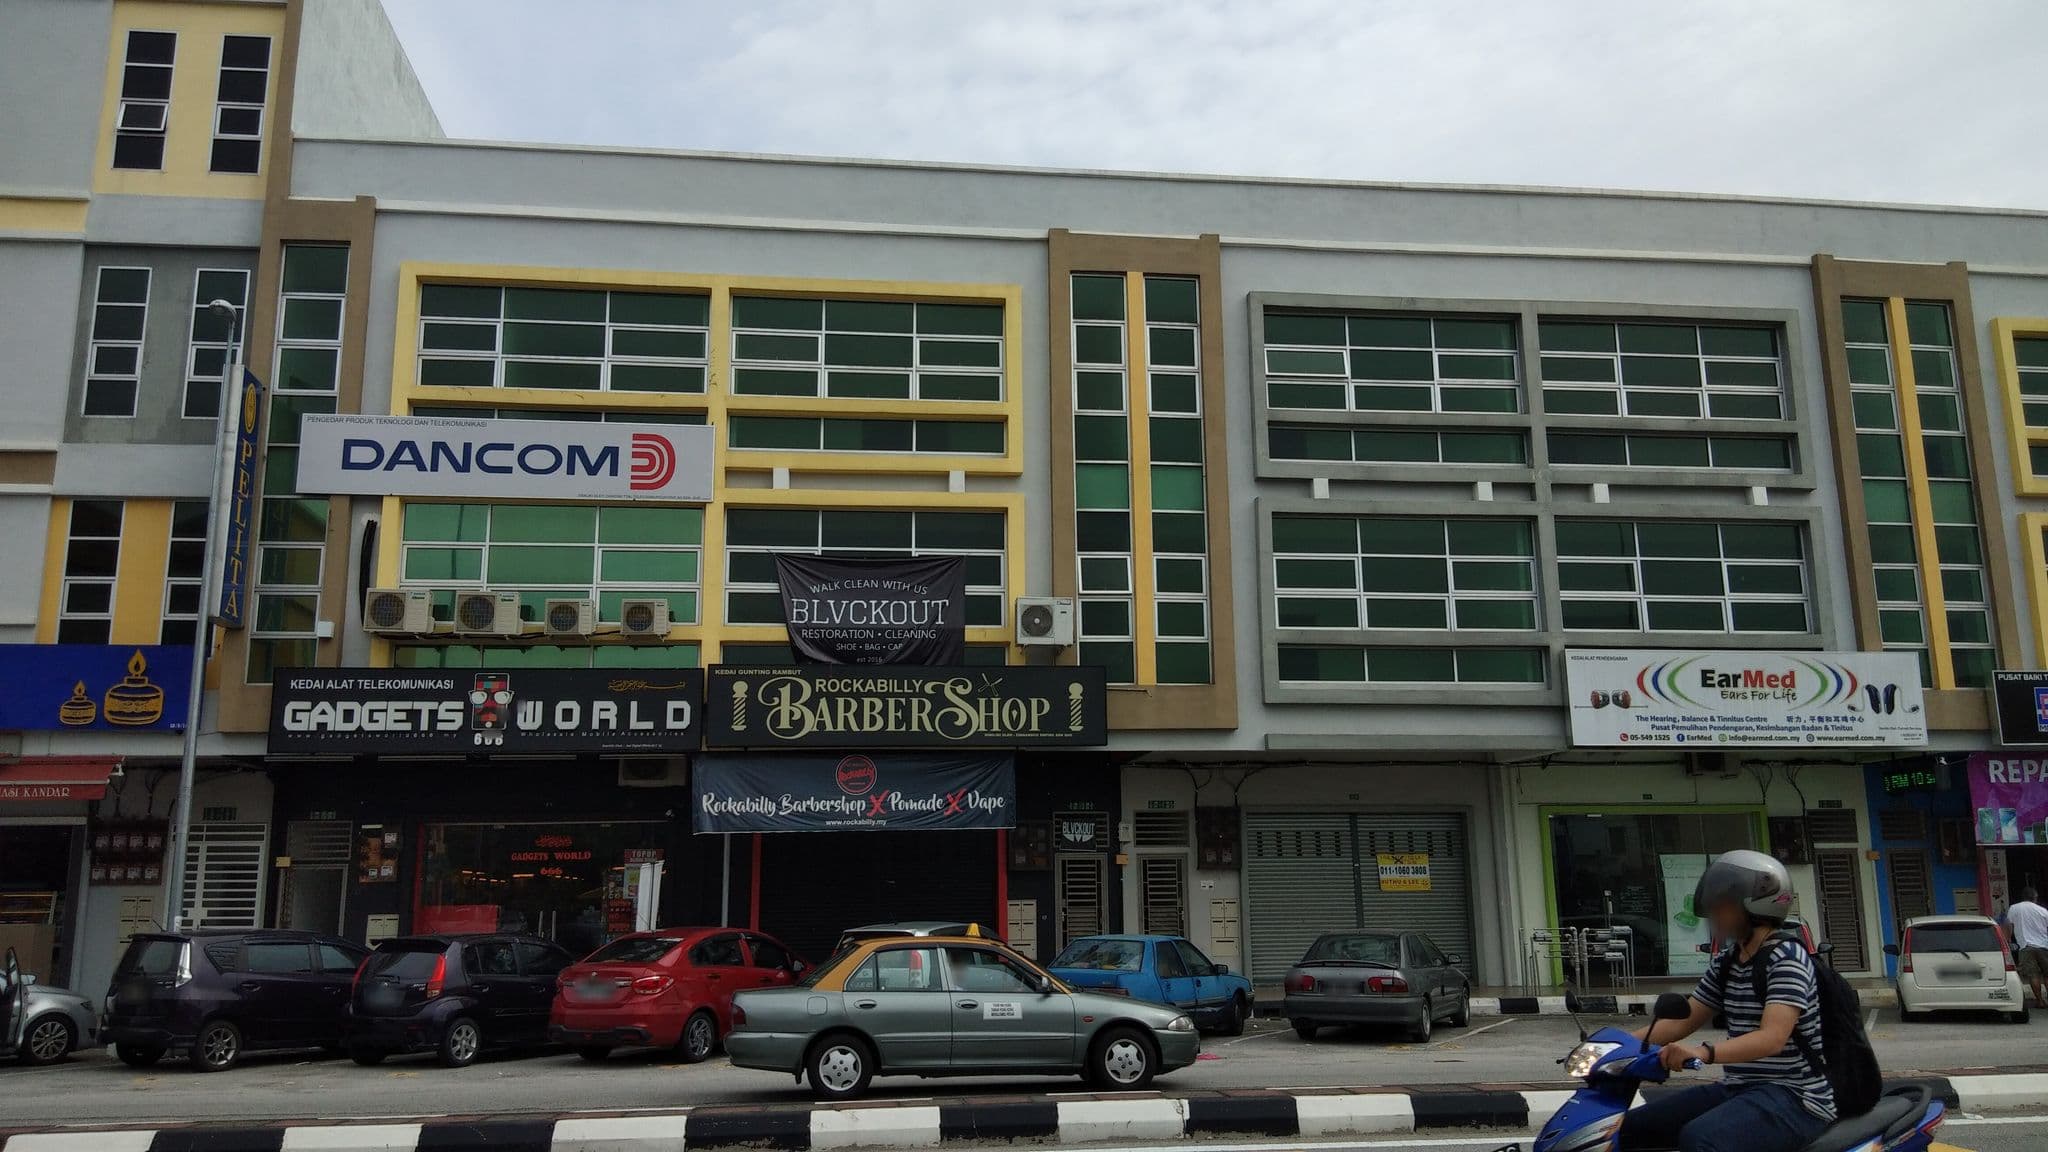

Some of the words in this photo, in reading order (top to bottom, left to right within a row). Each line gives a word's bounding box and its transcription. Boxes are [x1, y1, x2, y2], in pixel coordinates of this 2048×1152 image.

[306, 416, 344, 424] PENGEDAR
[345, 417, 374, 425] PRODUK
[376, 418, 413, 426] TEKNOLOGI
[430, 420, 488, 428] TELEKOMUNIKASI
[341, 438, 620, 477] DANCOM
[224, 438, 253, 618] PELITA
[809, 581, 841, 594] WALK
[844, 580, 879, 589] CLEAN
[882, 580, 910, 592] WITH
[913, 584, 928, 595] US
[790, 598, 949, 625] BLVCKOUT
[802, 629, 874, 639] RESTORATION
[885, 629, 937, 639] CLEANING
[836, 643, 857, 651] SHOE
[864, 643, 880, 651] BAG
[888, 643, 903, 651] CAP
[1701, 669, 1796, 688] EarMed
[1998, 673, 2022, 681] PUSAT
[2023, 673, 2043, 681] BAIKI
[290, 679, 324, 690] KEDAI
[326, 679, 354, 690] ALAT
[357, 679, 454, 690] TELEKOMUNIKASI
[815, 678, 923, 693] ROCKABILLY
[1720, 690, 1748, 700] Ears
[1751, 690, 1769, 700] For
[1773, 688, 1797, 703] Life
[283, 701, 465, 731] GADGETS
[516, 700, 691, 730] WORLD
[1650, 715, 1680, 723] Hearing,
[1709, 724, 1755, 732] Pendengaran,
[1728, 734, 1801, 742] info@earmed.com.my
[1816, 734, 1886, 742] www.earmed.com.my
[24, 787, 70, 797] KANDAR
[702, 792, 777, 817] Rockabilly
[778, 793, 866, 817] Barbershop
[888, 791, 944, 811] Pomade
[967, 791, 1006, 809] Vape
[825, 818, 887, 827] www.rockabilly.my
[1062, 821, 1096, 835] BLVCKOUT
[511, 851, 549, 862] GADGETS
[553, 850, 592, 861] WORLD
